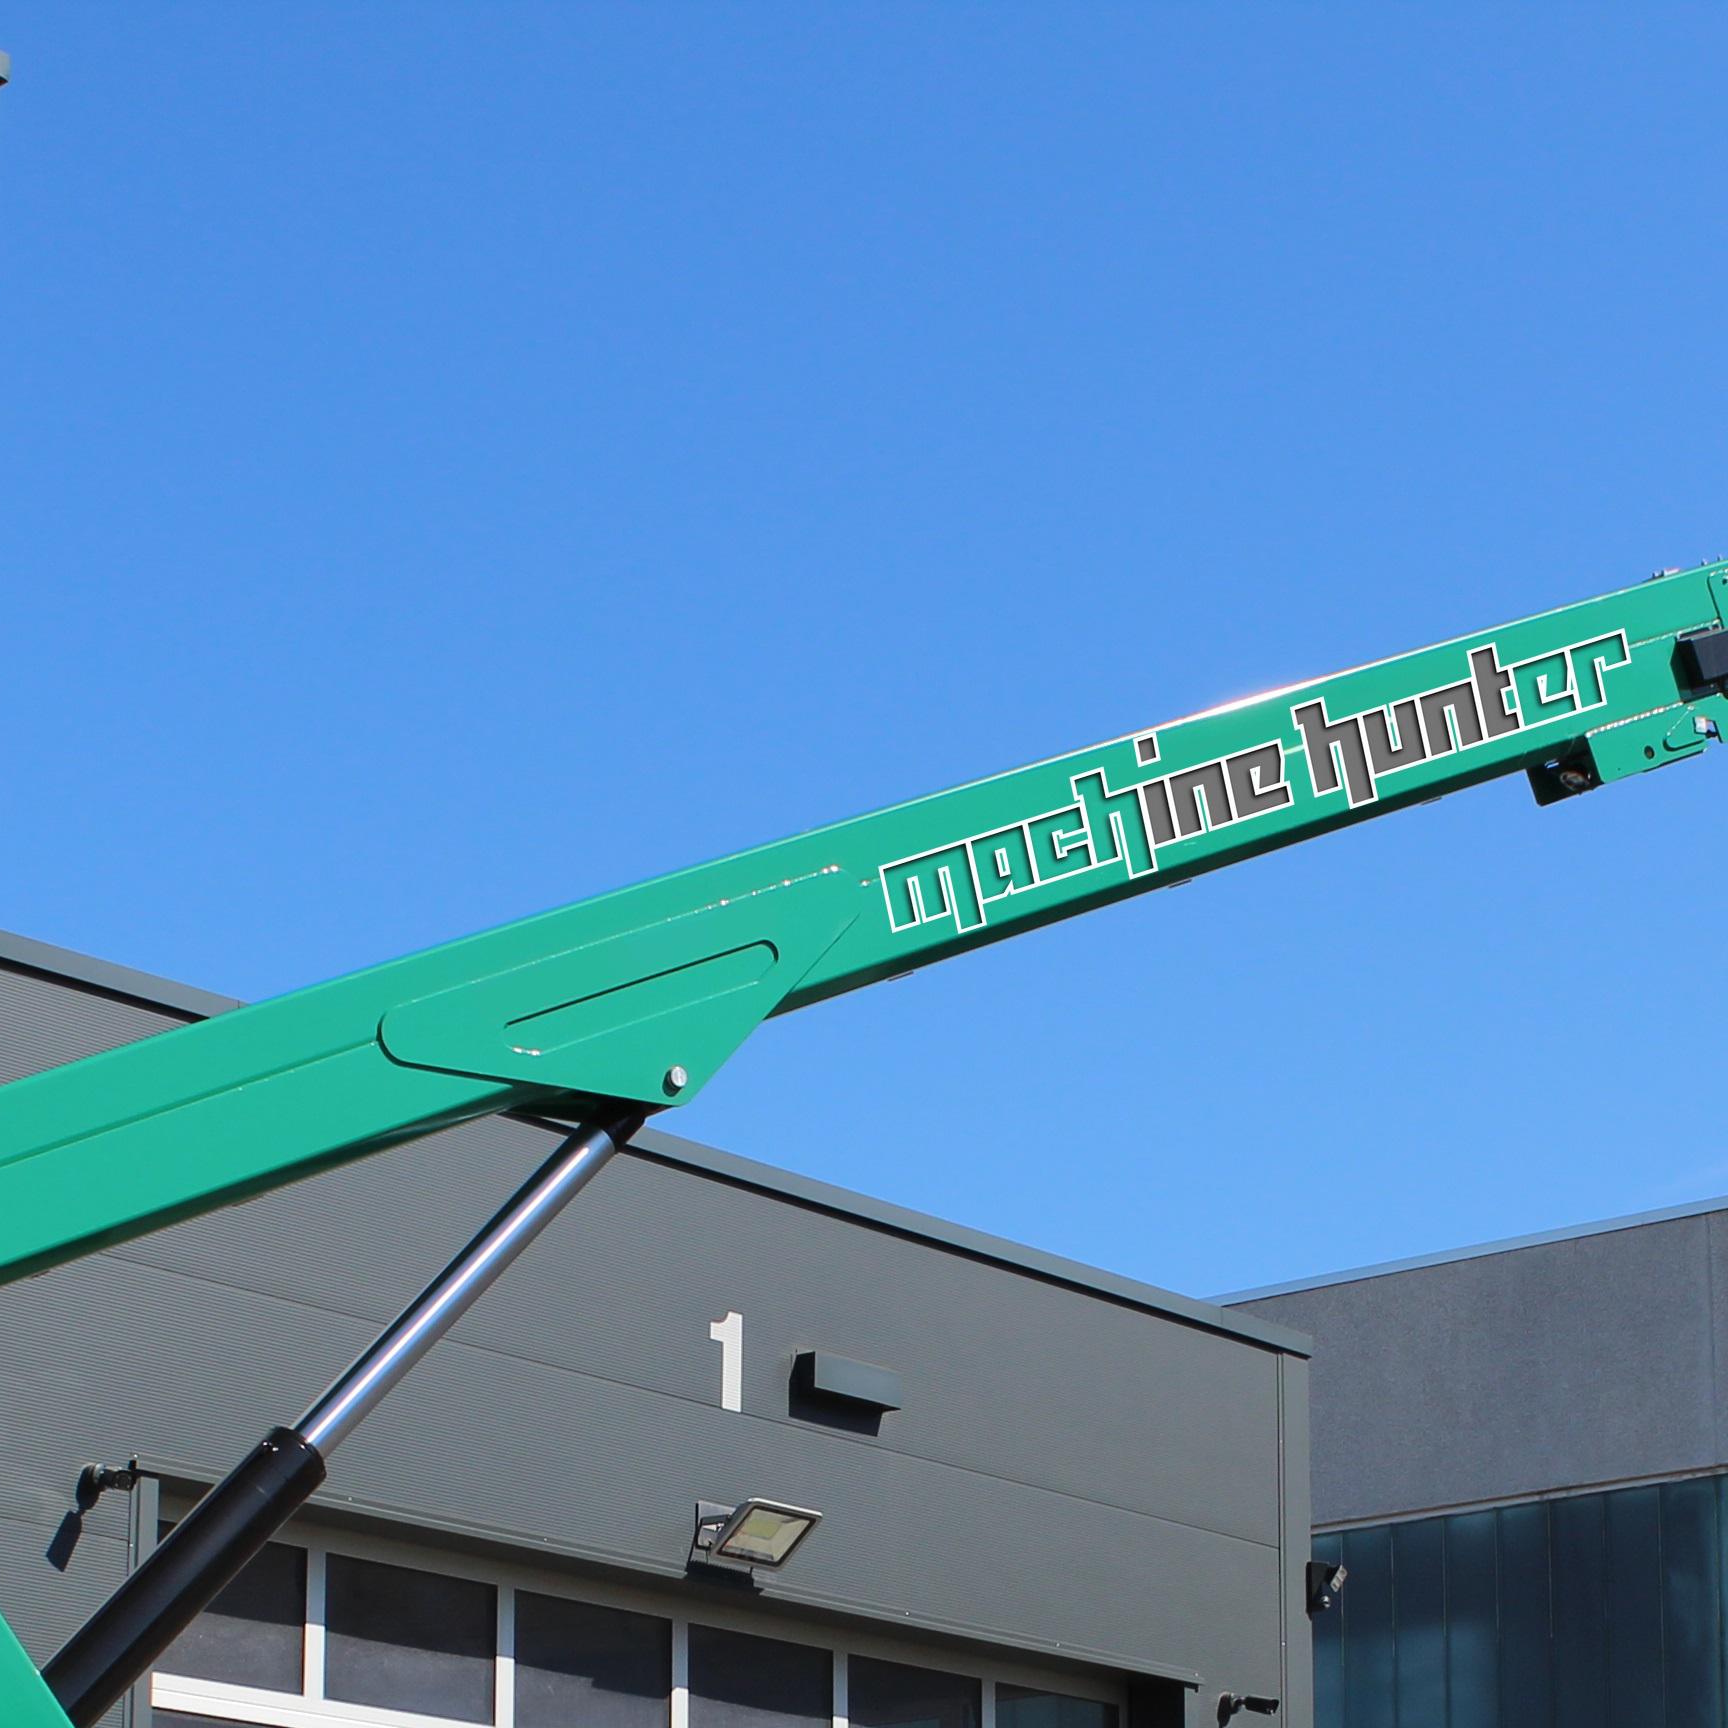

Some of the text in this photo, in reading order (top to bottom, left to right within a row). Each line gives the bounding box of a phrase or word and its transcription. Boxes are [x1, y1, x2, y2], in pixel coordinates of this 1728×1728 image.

[879, 628, 1632, 934] machine hunter
[709, 1311, 743, 1413] 1
